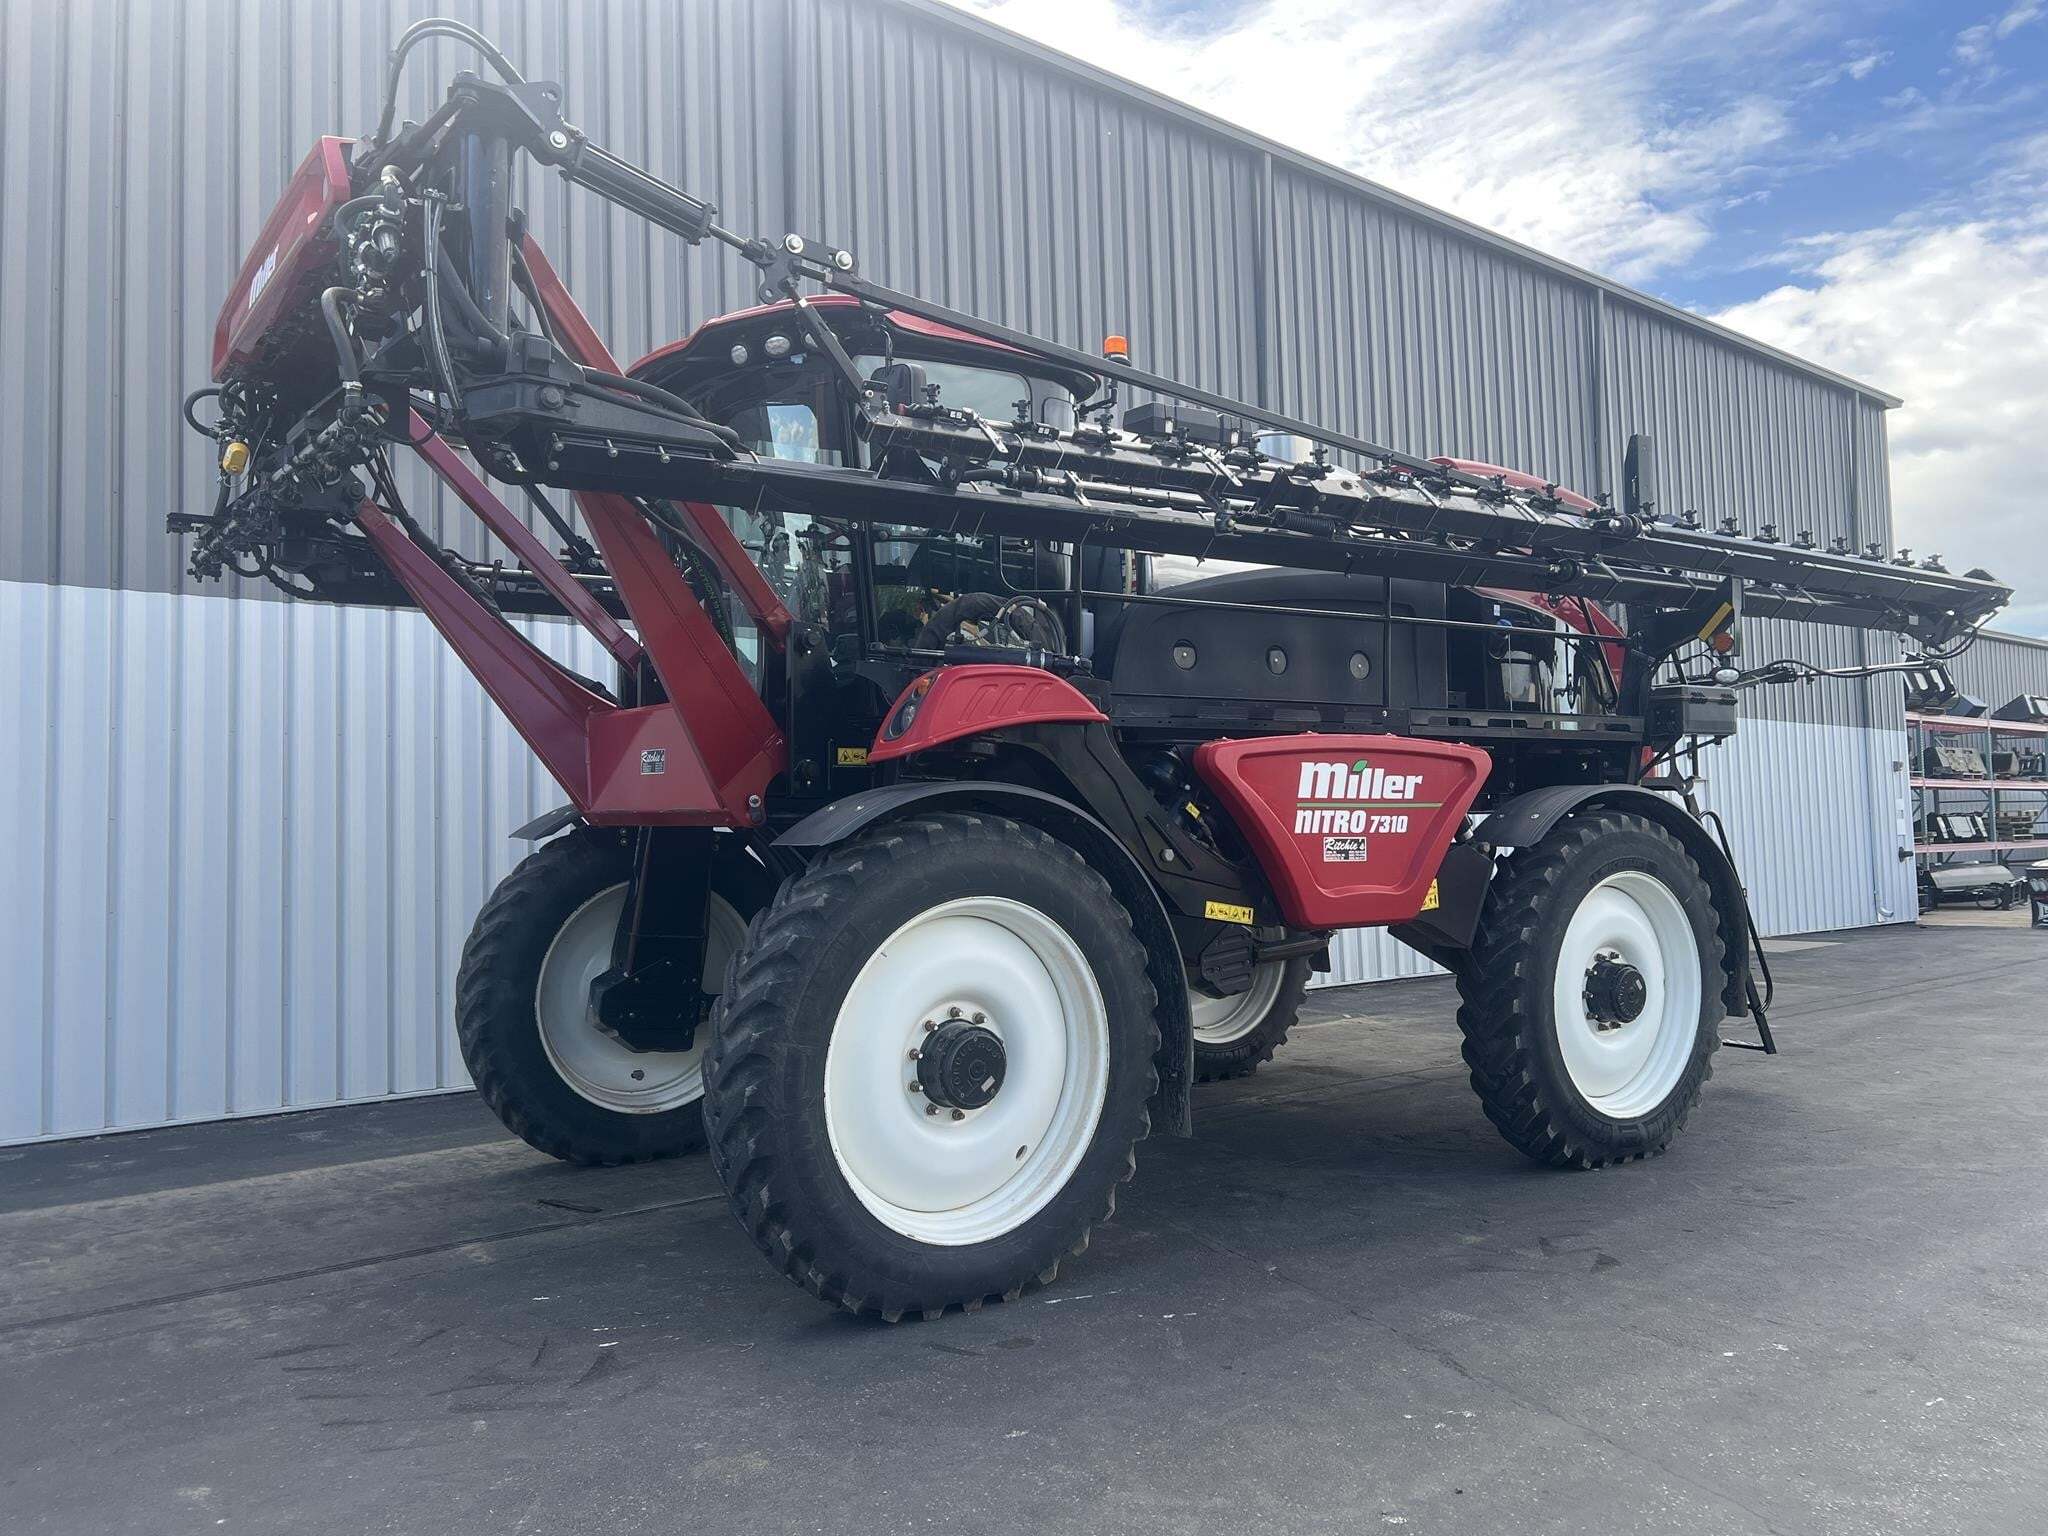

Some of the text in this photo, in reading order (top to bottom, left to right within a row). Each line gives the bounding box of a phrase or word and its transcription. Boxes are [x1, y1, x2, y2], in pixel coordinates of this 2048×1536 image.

[1298, 761, 1423, 799] Miller
[1294, 810, 1409, 834] NITRO 7310
[1325, 838, 1365, 851] Ritchie's
